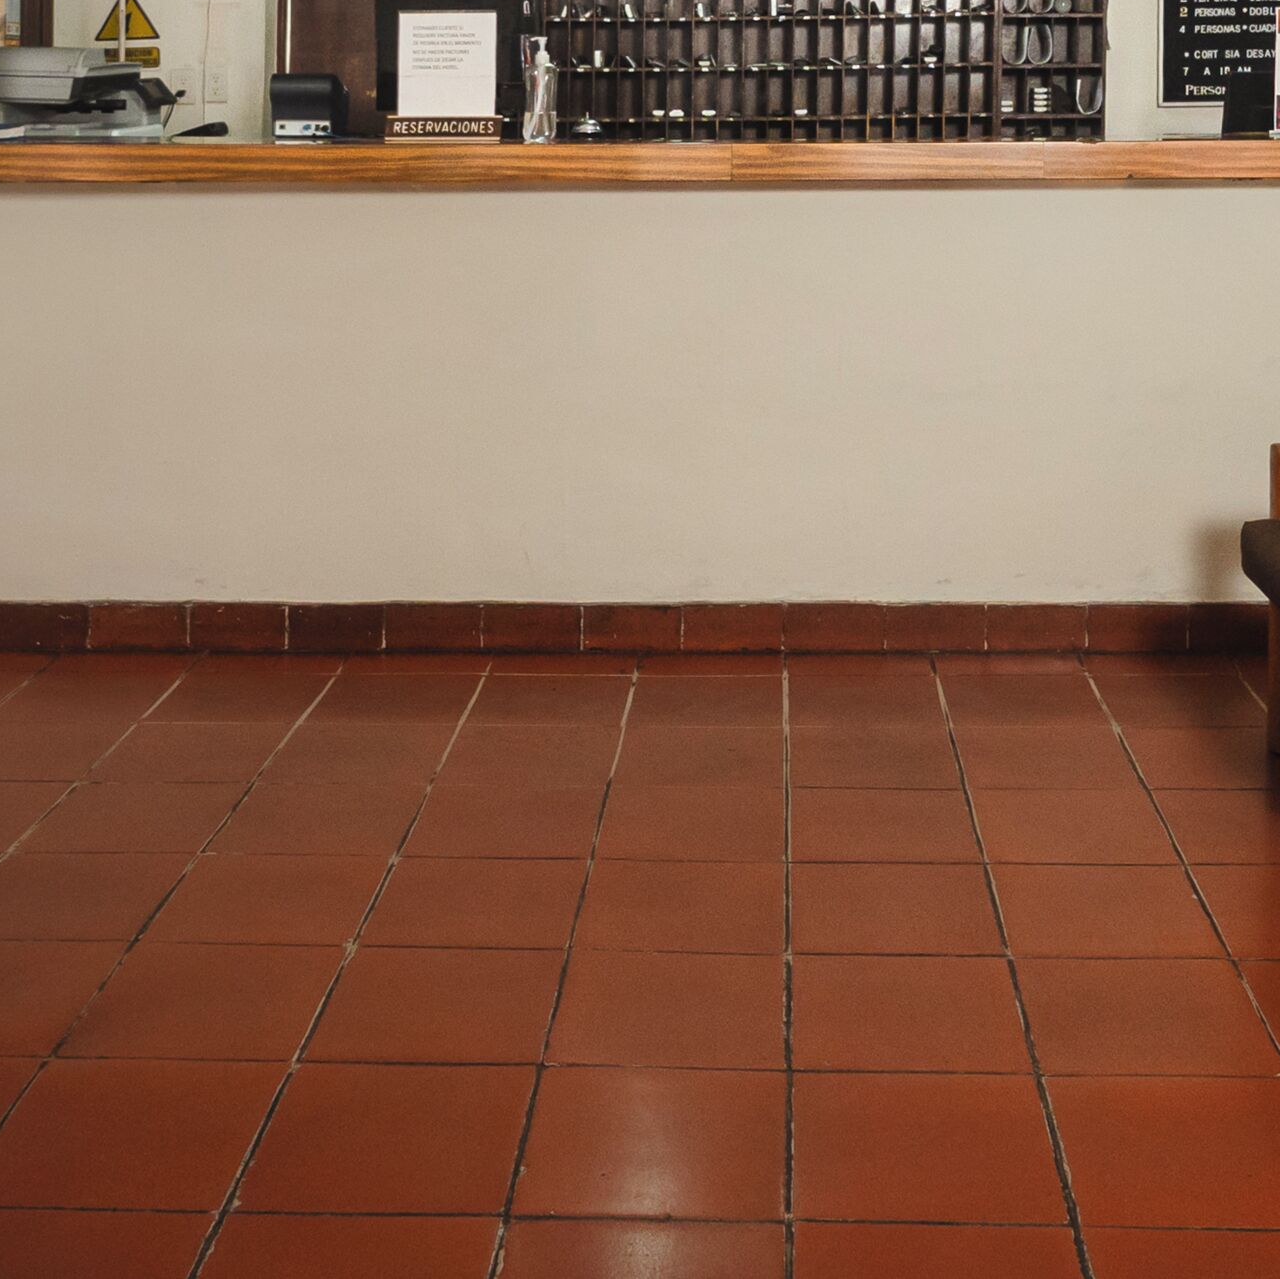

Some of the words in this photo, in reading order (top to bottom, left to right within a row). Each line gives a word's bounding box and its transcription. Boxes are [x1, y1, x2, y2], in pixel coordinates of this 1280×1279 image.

[1180, 7, 1188, 17] 2
[1194, 8, 1236, 17] PERSONAS
[1249, 7, 1276, 16] DOBL
[1179, 25, 1185, 33] 4
[1194, 24, 1241, 34] PERSONAS
[1246, 49, 1276, 58] DESAY
[1182, 68, 1189, 76] 7
[393, 121, 494, 134] RESERVACIONES
